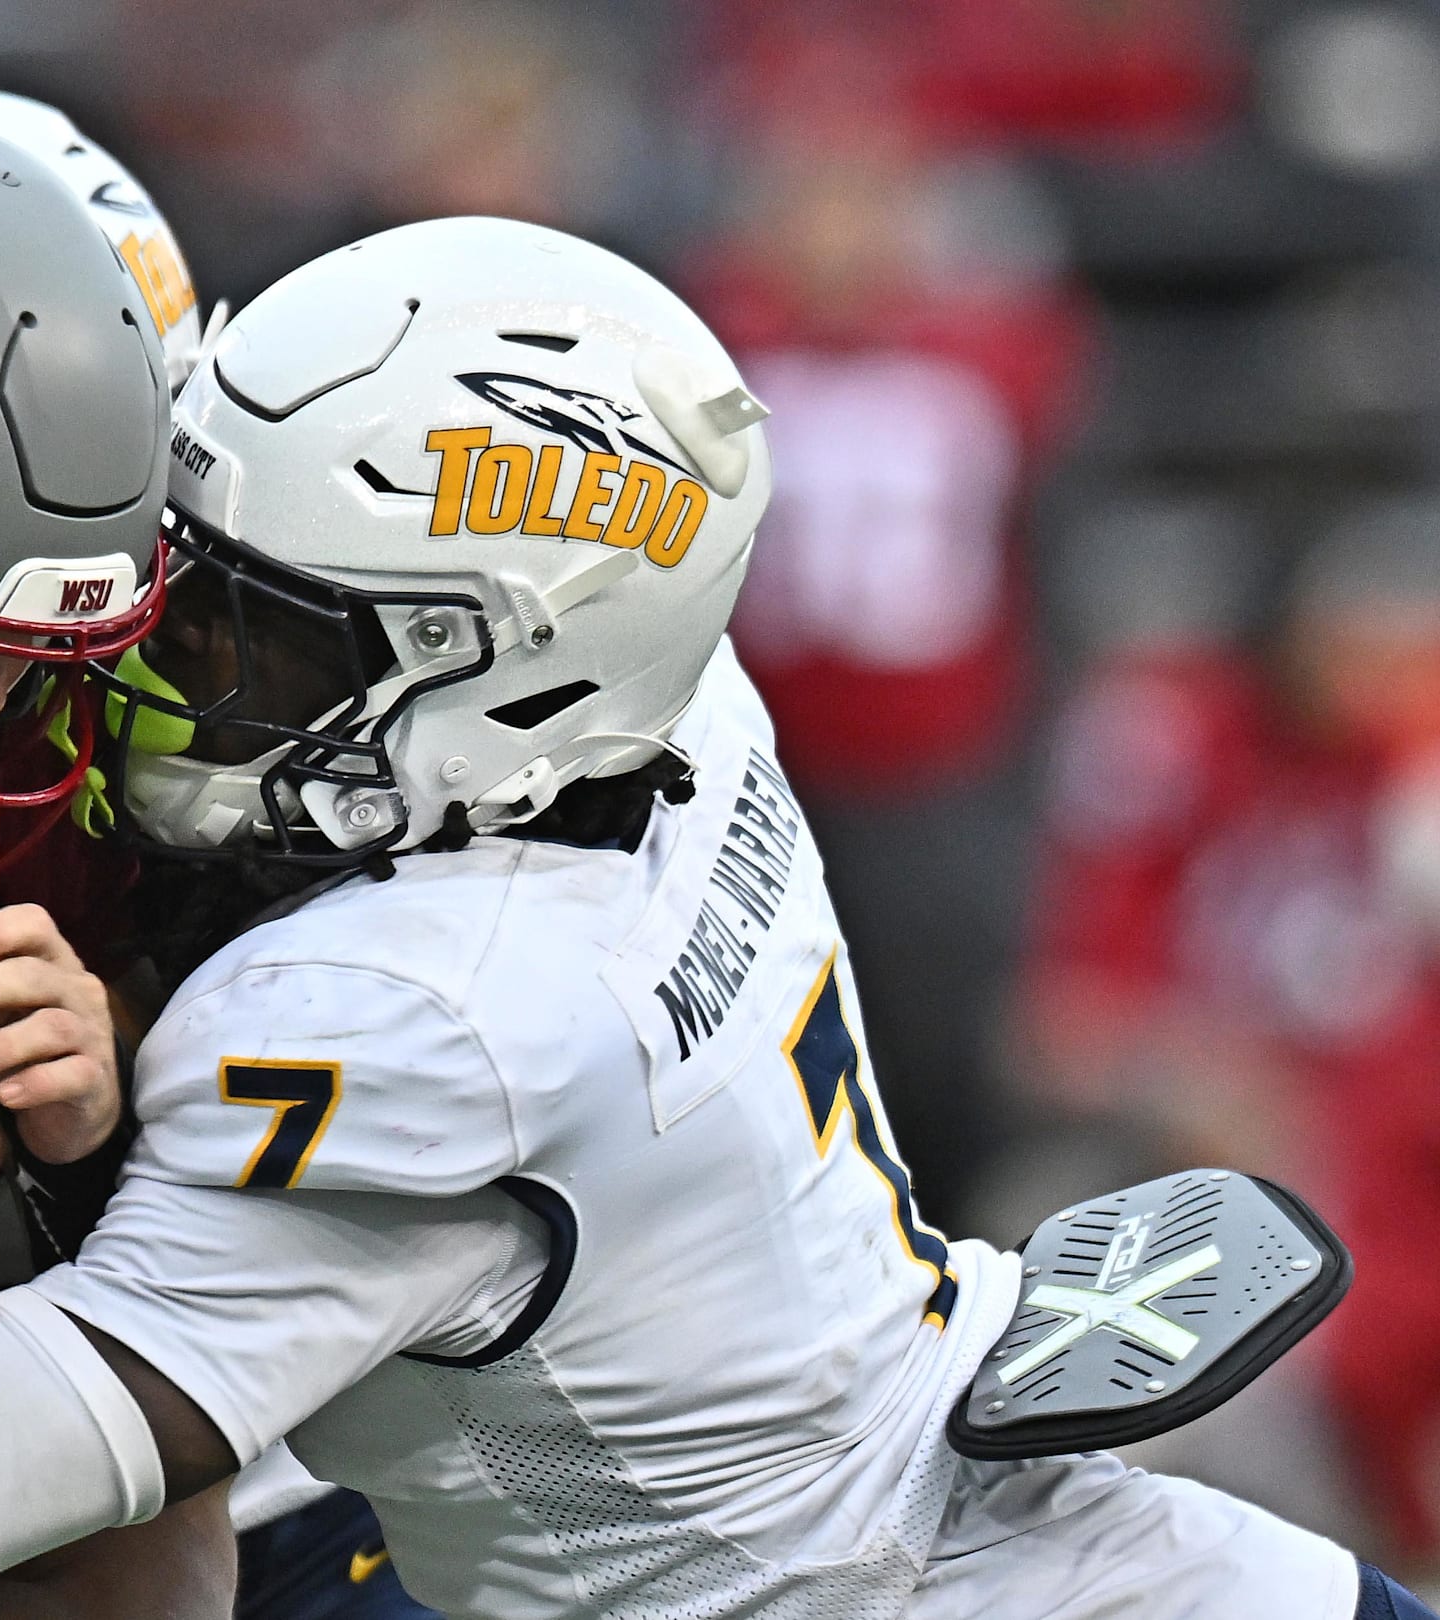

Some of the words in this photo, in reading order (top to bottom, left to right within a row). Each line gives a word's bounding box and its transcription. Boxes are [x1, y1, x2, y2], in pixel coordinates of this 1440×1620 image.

[184, 442, 217, 480] CITY
[425, 426, 709, 568] TOLEDO
[60, 578, 114, 612] WSU
[217, 1055, 344, 1191] 7
